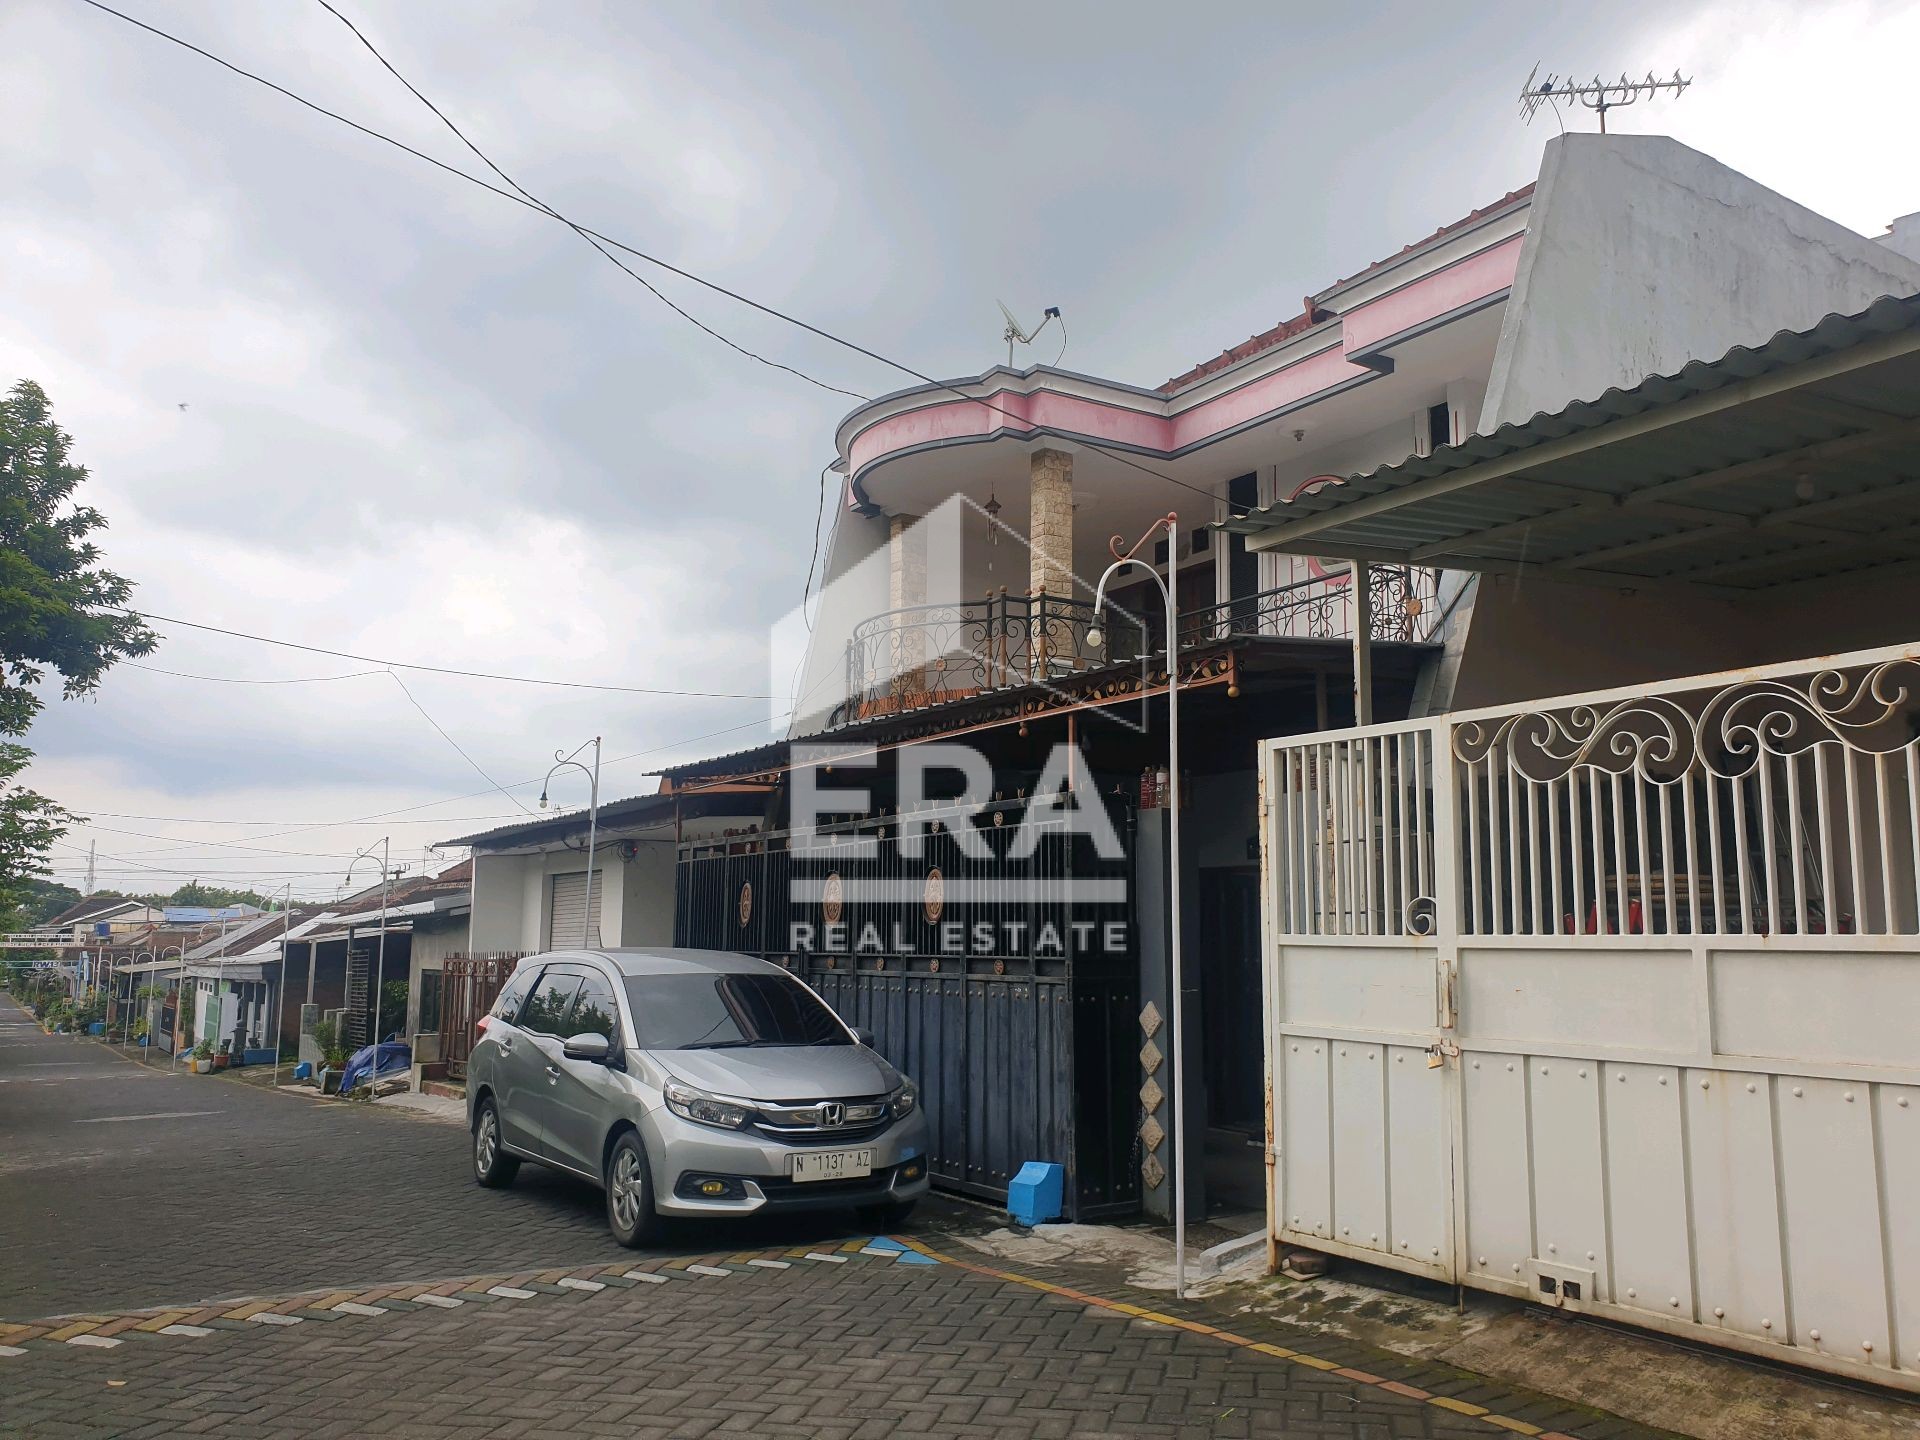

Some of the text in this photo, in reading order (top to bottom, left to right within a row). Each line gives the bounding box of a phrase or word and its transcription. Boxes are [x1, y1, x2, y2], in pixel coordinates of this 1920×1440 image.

[796, 1151, 870, 1173] N 1137 AZ
